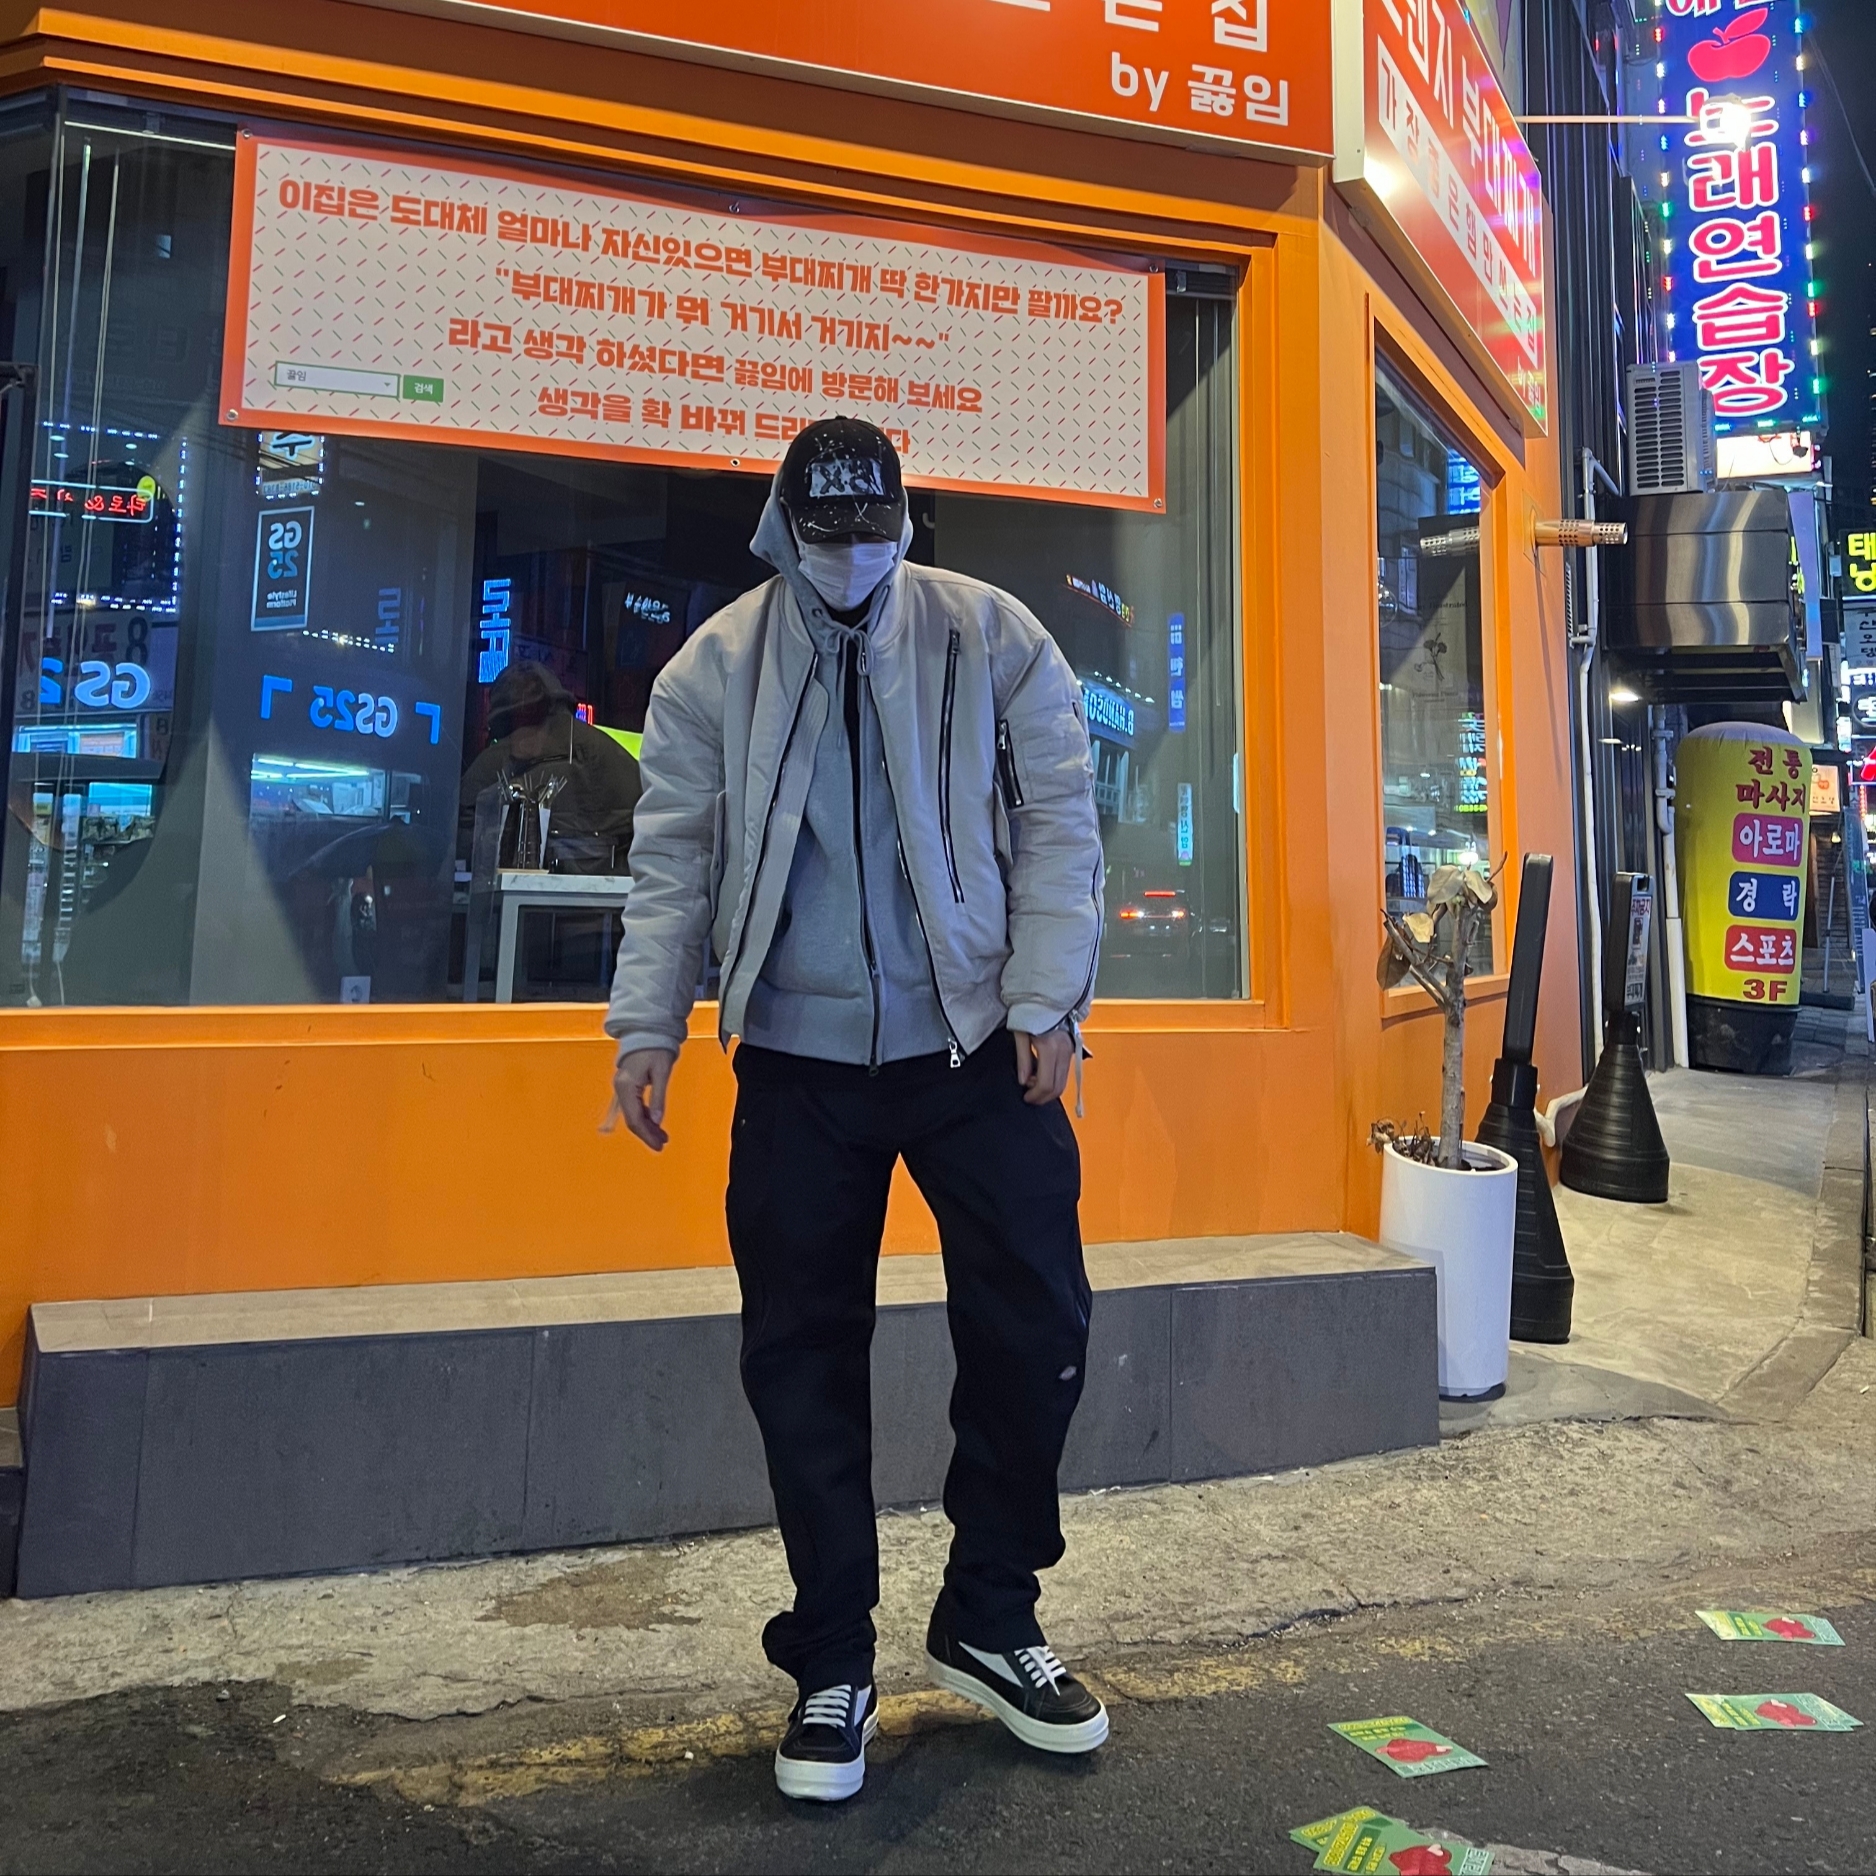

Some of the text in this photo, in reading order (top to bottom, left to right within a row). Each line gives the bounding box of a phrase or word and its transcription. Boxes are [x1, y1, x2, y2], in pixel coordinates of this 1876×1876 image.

[1111, 51, 1289, 127] by 끓임
[280, 180, 1123, 325] 이집은 도대체 얼마나 자신있으면 부대찌개 딱 한가지만 팔까요?
[676, 294, 709, 327] 뭐
[720, 301, 803, 341] 거기서
[449, 317, 983, 413] 라고 생각 하셨다면 끓임에 방문해 보세요
[414, 382, 434, 396] 검색
[538, 387, 631, 422] 생각을
[642, 397, 672, 429] 확
[680, 404, 746, 436] 바꿔
[1748, 746, 1803, 780] 전통
[1736, 778, 1808, 813] 마사지
[1739, 818, 1801, 862] 아로마
[1735, 879, 1798, 917] 경락
[1730, 932, 1795, 967] 스포츠
[1743, 978, 1788, 1002] 3F
